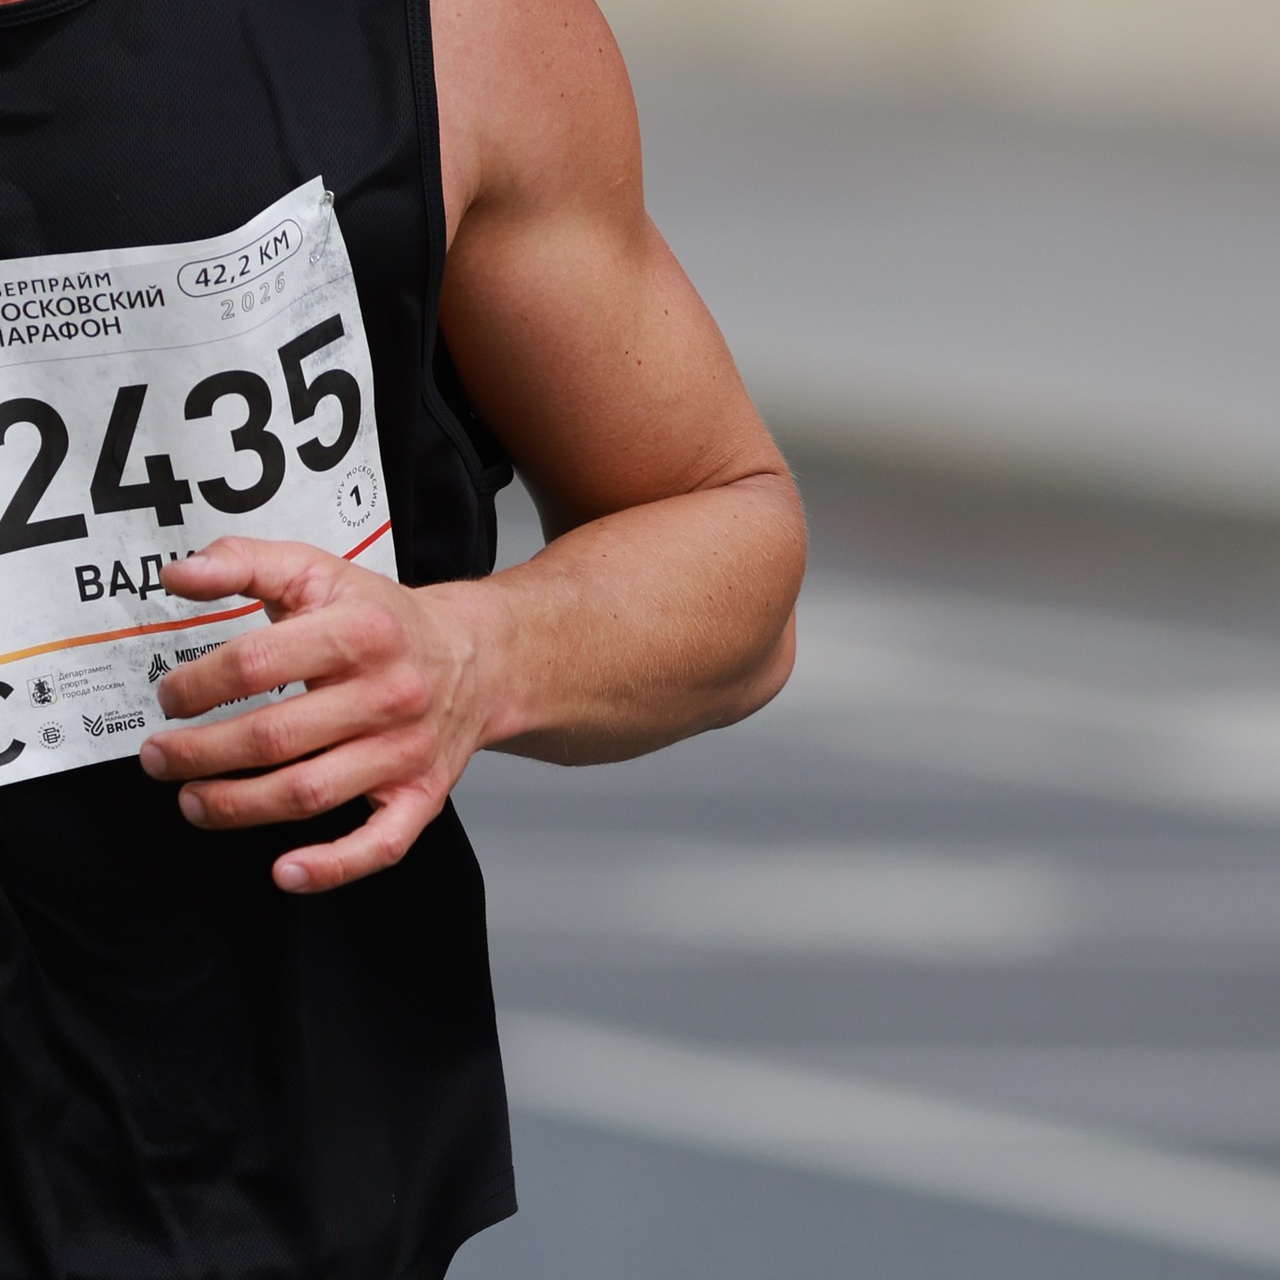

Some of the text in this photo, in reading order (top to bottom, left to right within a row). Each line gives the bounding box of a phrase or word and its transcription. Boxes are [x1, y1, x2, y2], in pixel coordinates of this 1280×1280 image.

[195, 229, 290, 287] 42,2 КМ
[220, 271, 286, 321] 2026
[349, 484, 362, 507] 1
[74, 550, 196, 602] ВАД
[106, 717, 146, 734] BRICS
